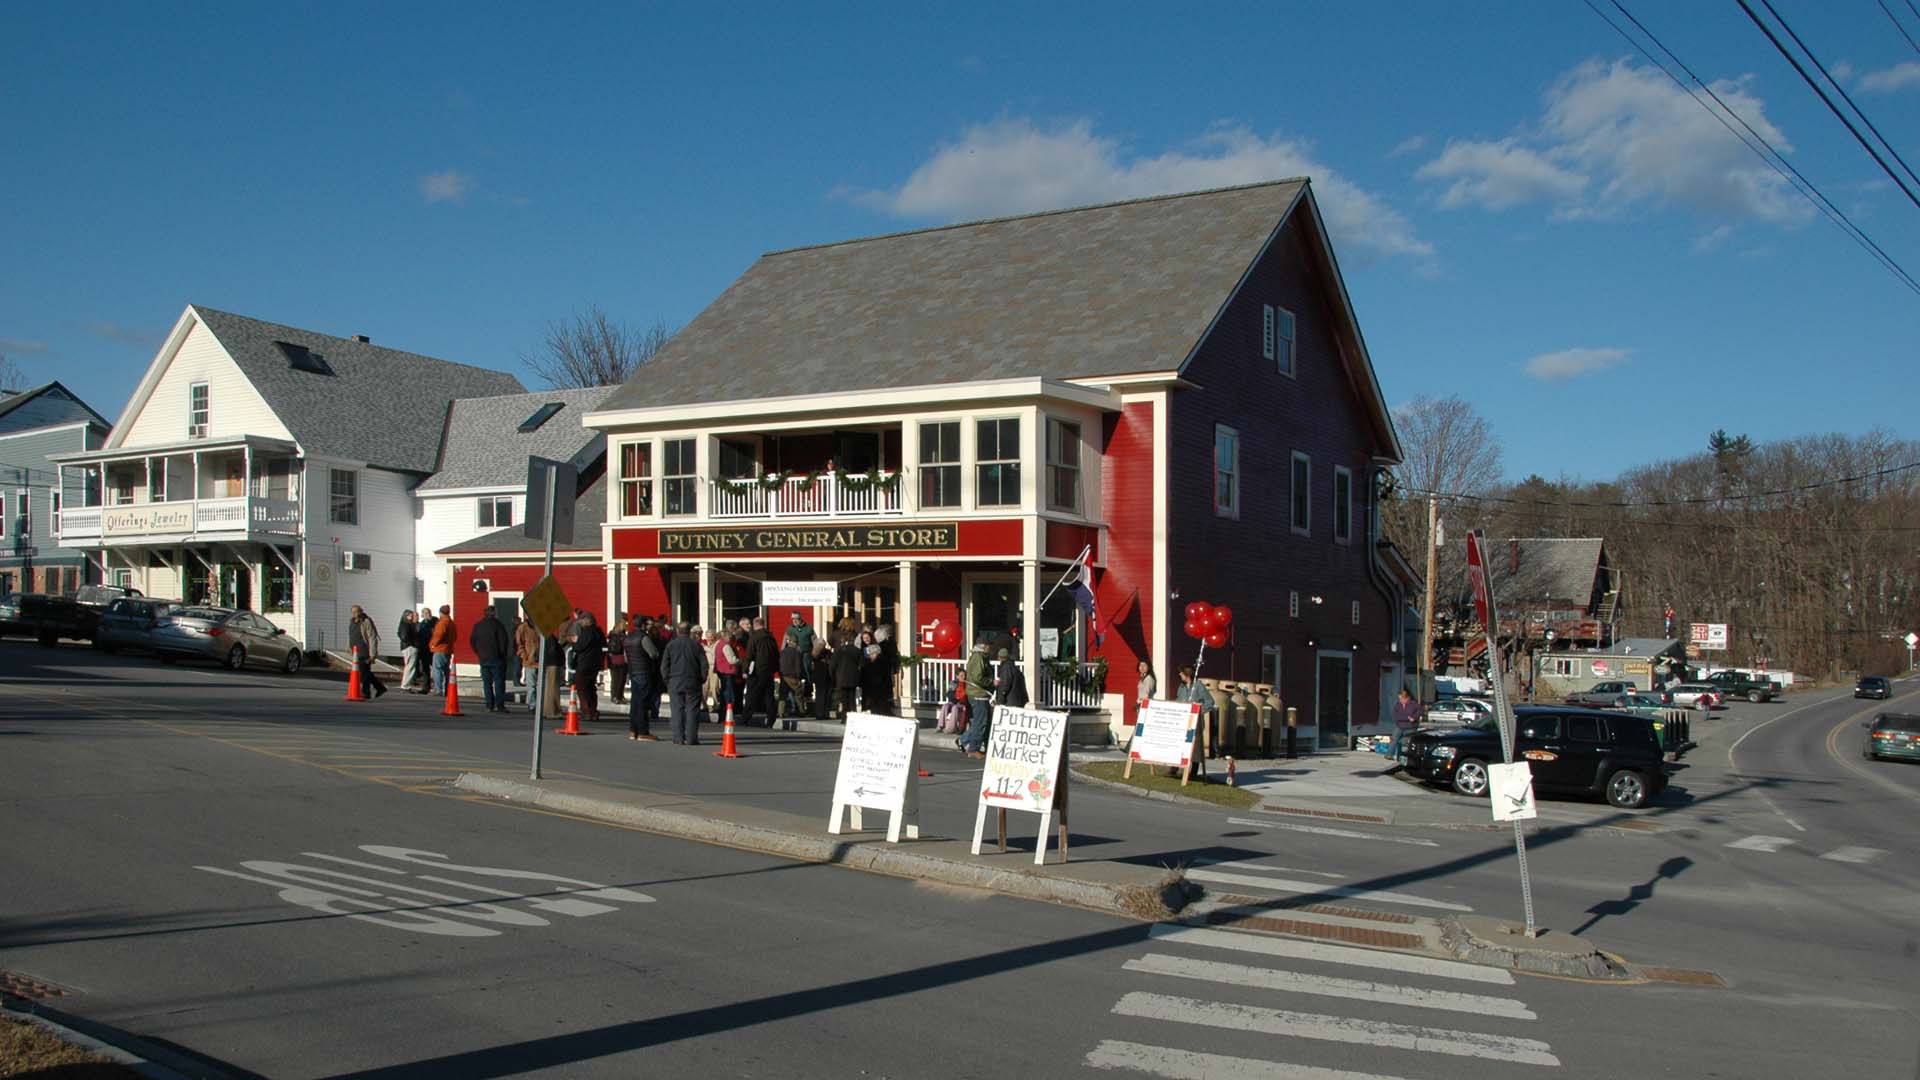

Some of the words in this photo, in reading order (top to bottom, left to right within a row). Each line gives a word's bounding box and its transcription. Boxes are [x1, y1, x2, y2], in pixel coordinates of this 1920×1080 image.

[107, 513, 148, 531] Offerings
[150, 511, 189, 529] Jewelry
[666, 533, 750, 550] PUTNEY
[756, 530, 861, 549] GENERAL
[867, 528, 949, 547] STORE
[998, 708, 1060, 735] Putney
[990, 741, 1048, 765] Market
[996, 776, 1023, 797] 11-2
